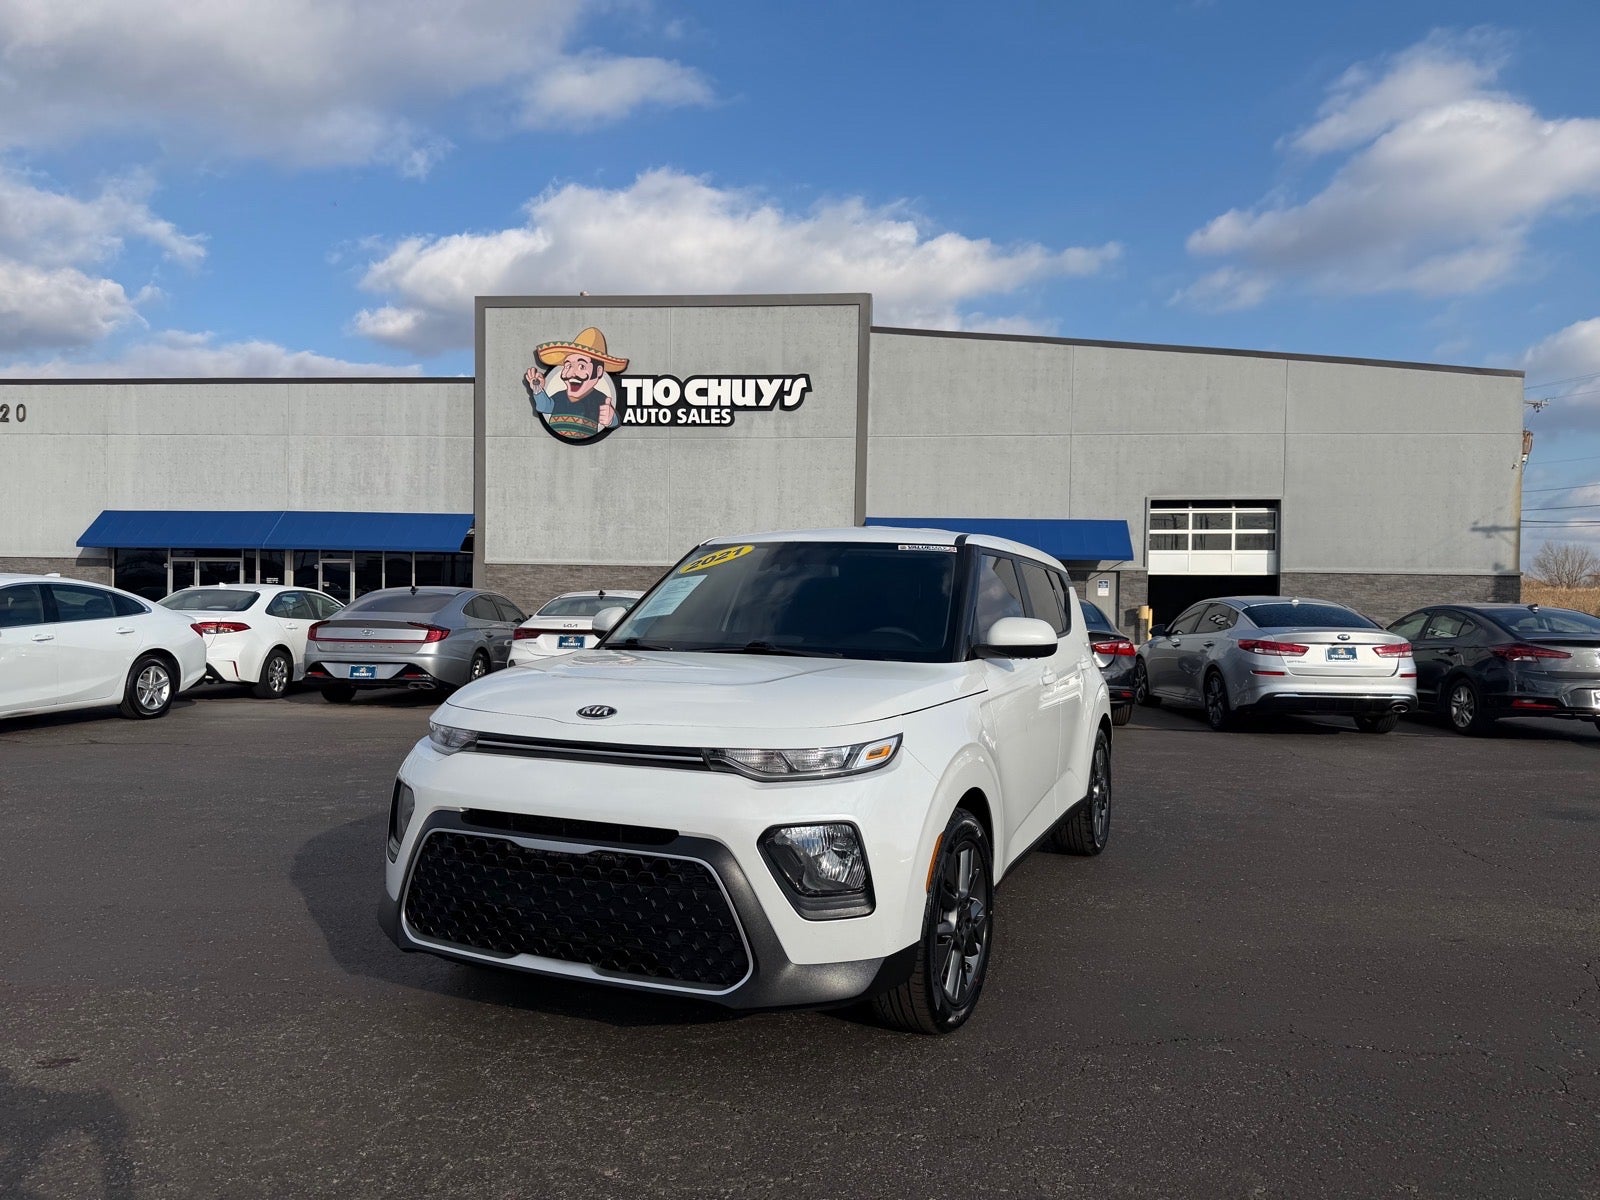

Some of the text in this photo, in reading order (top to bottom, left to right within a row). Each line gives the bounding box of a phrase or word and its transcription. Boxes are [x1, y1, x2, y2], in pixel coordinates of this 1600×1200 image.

[621, 377, 807, 407] TIO CHUY'S
[623, 408, 732, 424] AUTO SALES
[684, 546, 745, 572] 2021
[580, 705, 610, 716] KIA
